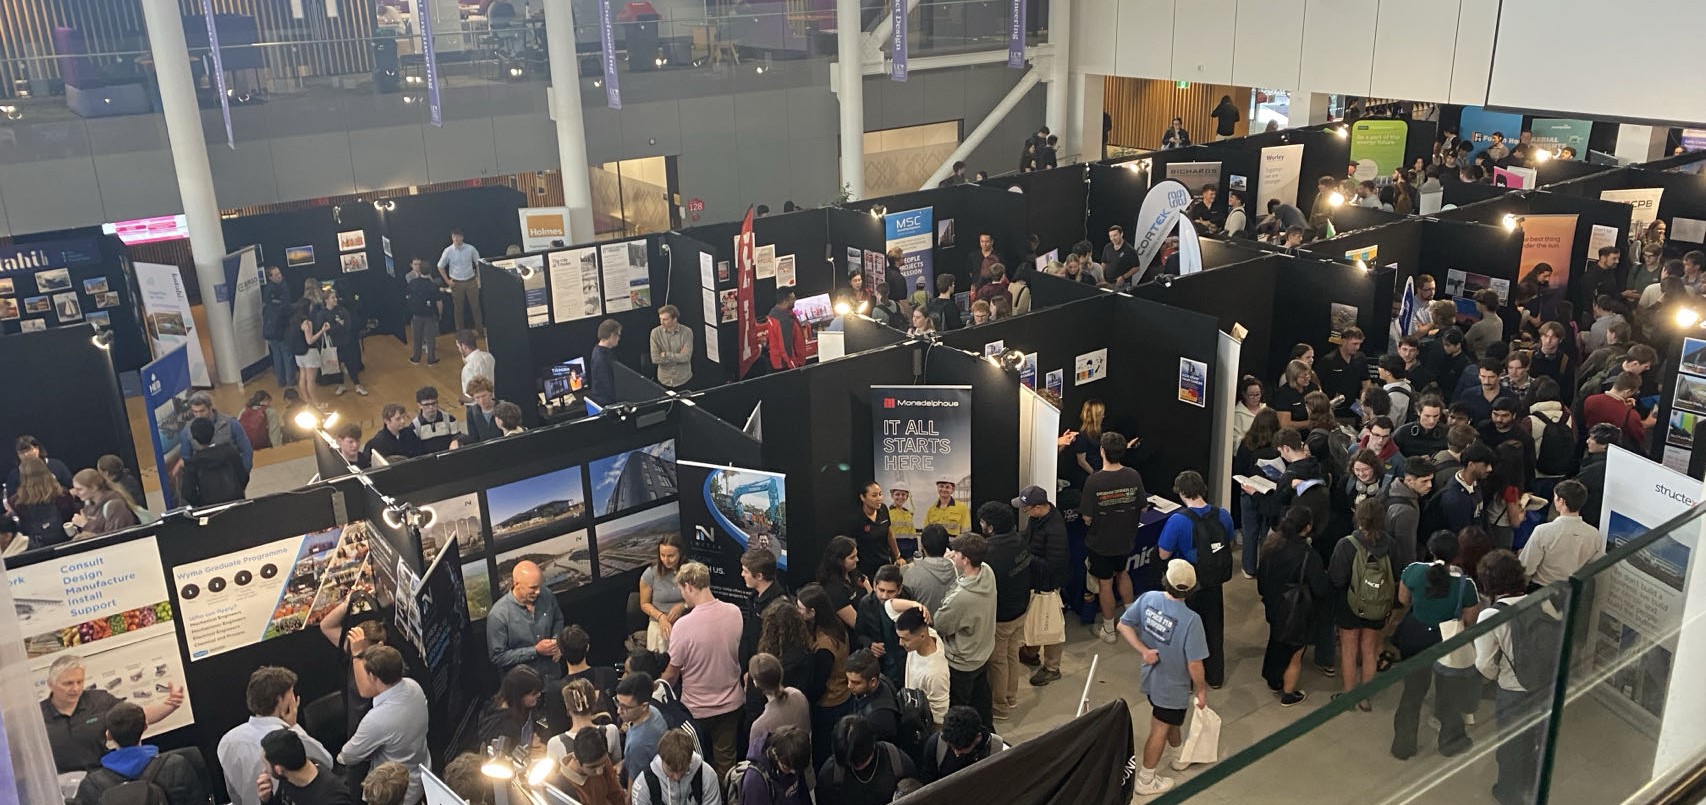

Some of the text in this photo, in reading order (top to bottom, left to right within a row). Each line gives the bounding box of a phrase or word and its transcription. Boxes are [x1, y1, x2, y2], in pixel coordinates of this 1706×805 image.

[690, 202, 702, 212] 128
[896, 216, 921, 229] MSC
[530, 227, 563, 236] Holmes
[1136, 209, 1170, 256] CORTEK
[904, 255, 921, 264] EOPLE
[883, 420, 939, 435] IT ALL
[883, 438, 951, 454] STARTS
[884, 455, 934, 471] HERE
[60, 556, 105, 574] Consult
[176, 548, 288, 580] Wyma Graduate Programme
[63, 570, 103, 586] Design
[65, 573, 136, 595] Manufacture
[67, 591, 102, 606] Install
[70, 600, 117, 618] Support
